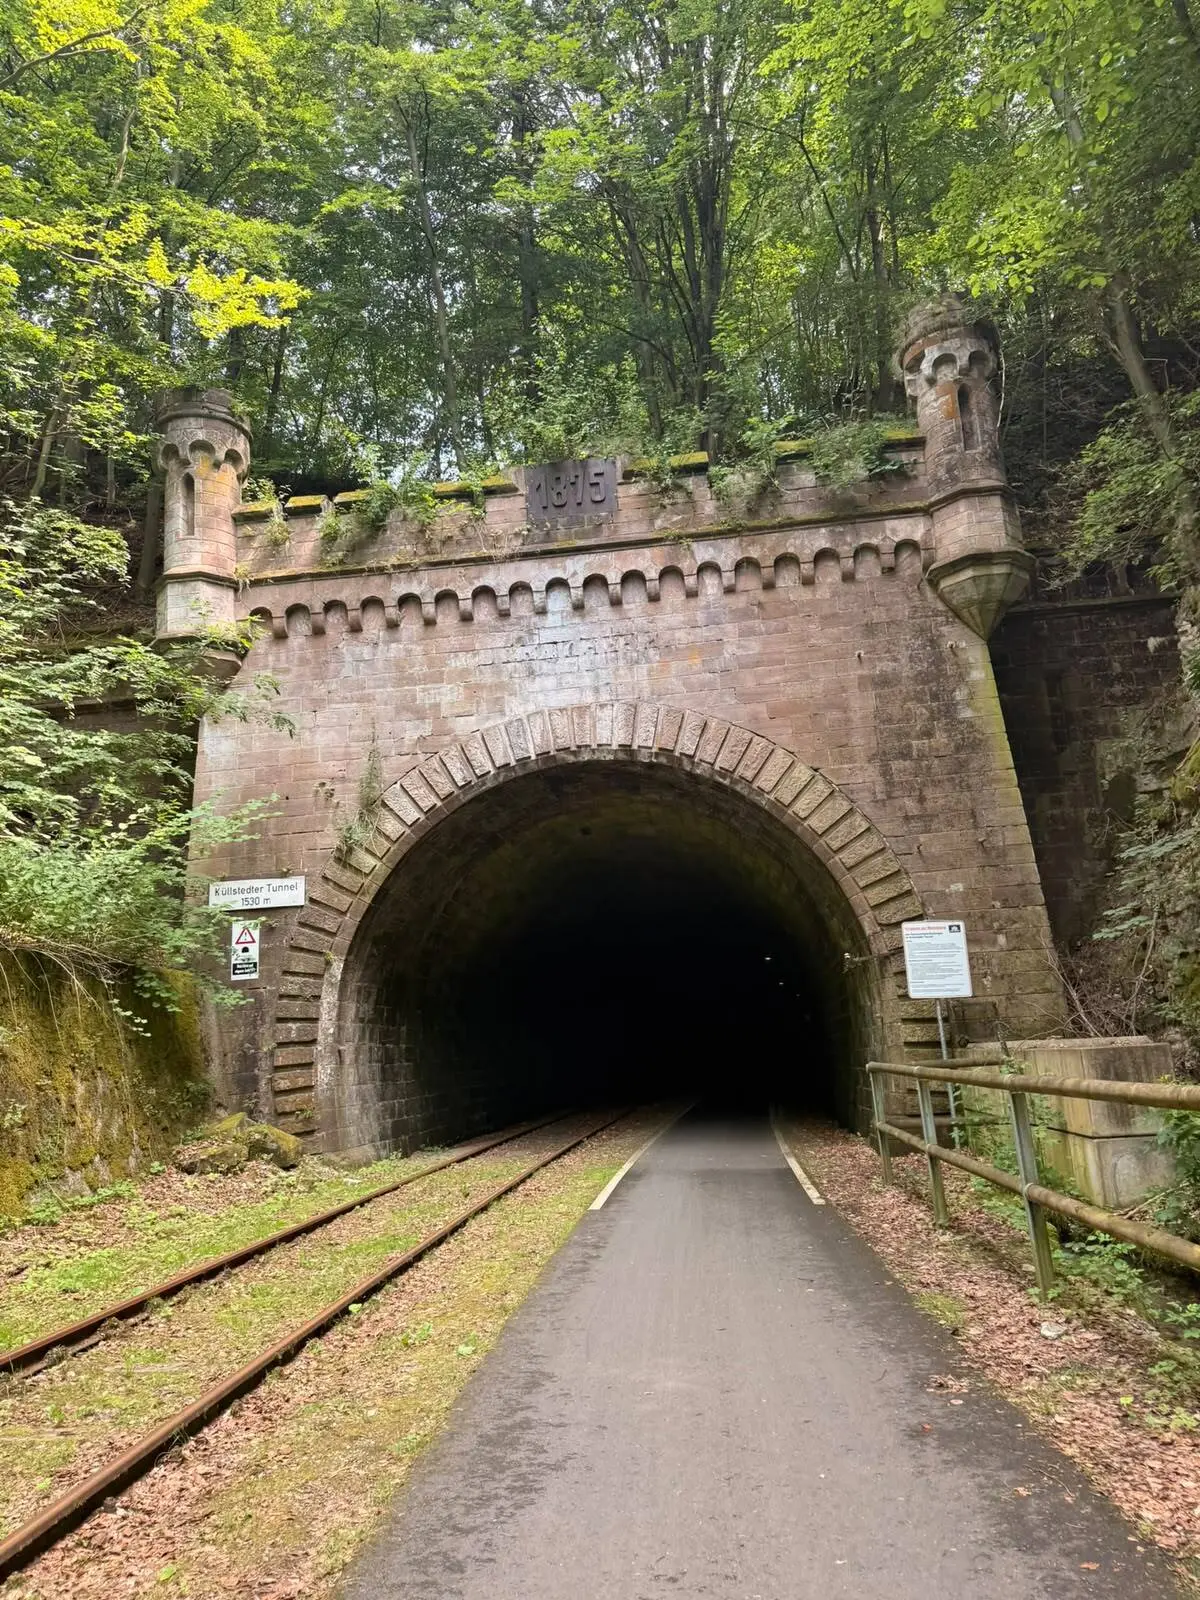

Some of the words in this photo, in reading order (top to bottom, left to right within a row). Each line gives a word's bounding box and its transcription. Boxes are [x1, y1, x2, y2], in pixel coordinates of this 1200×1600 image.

[535, 468, 607, 509] 1875
[214, 885, 264, 896] Küllstedter
[267, 882, 298, 893] Tunnel
[241, 897, 260, 906] 1530
